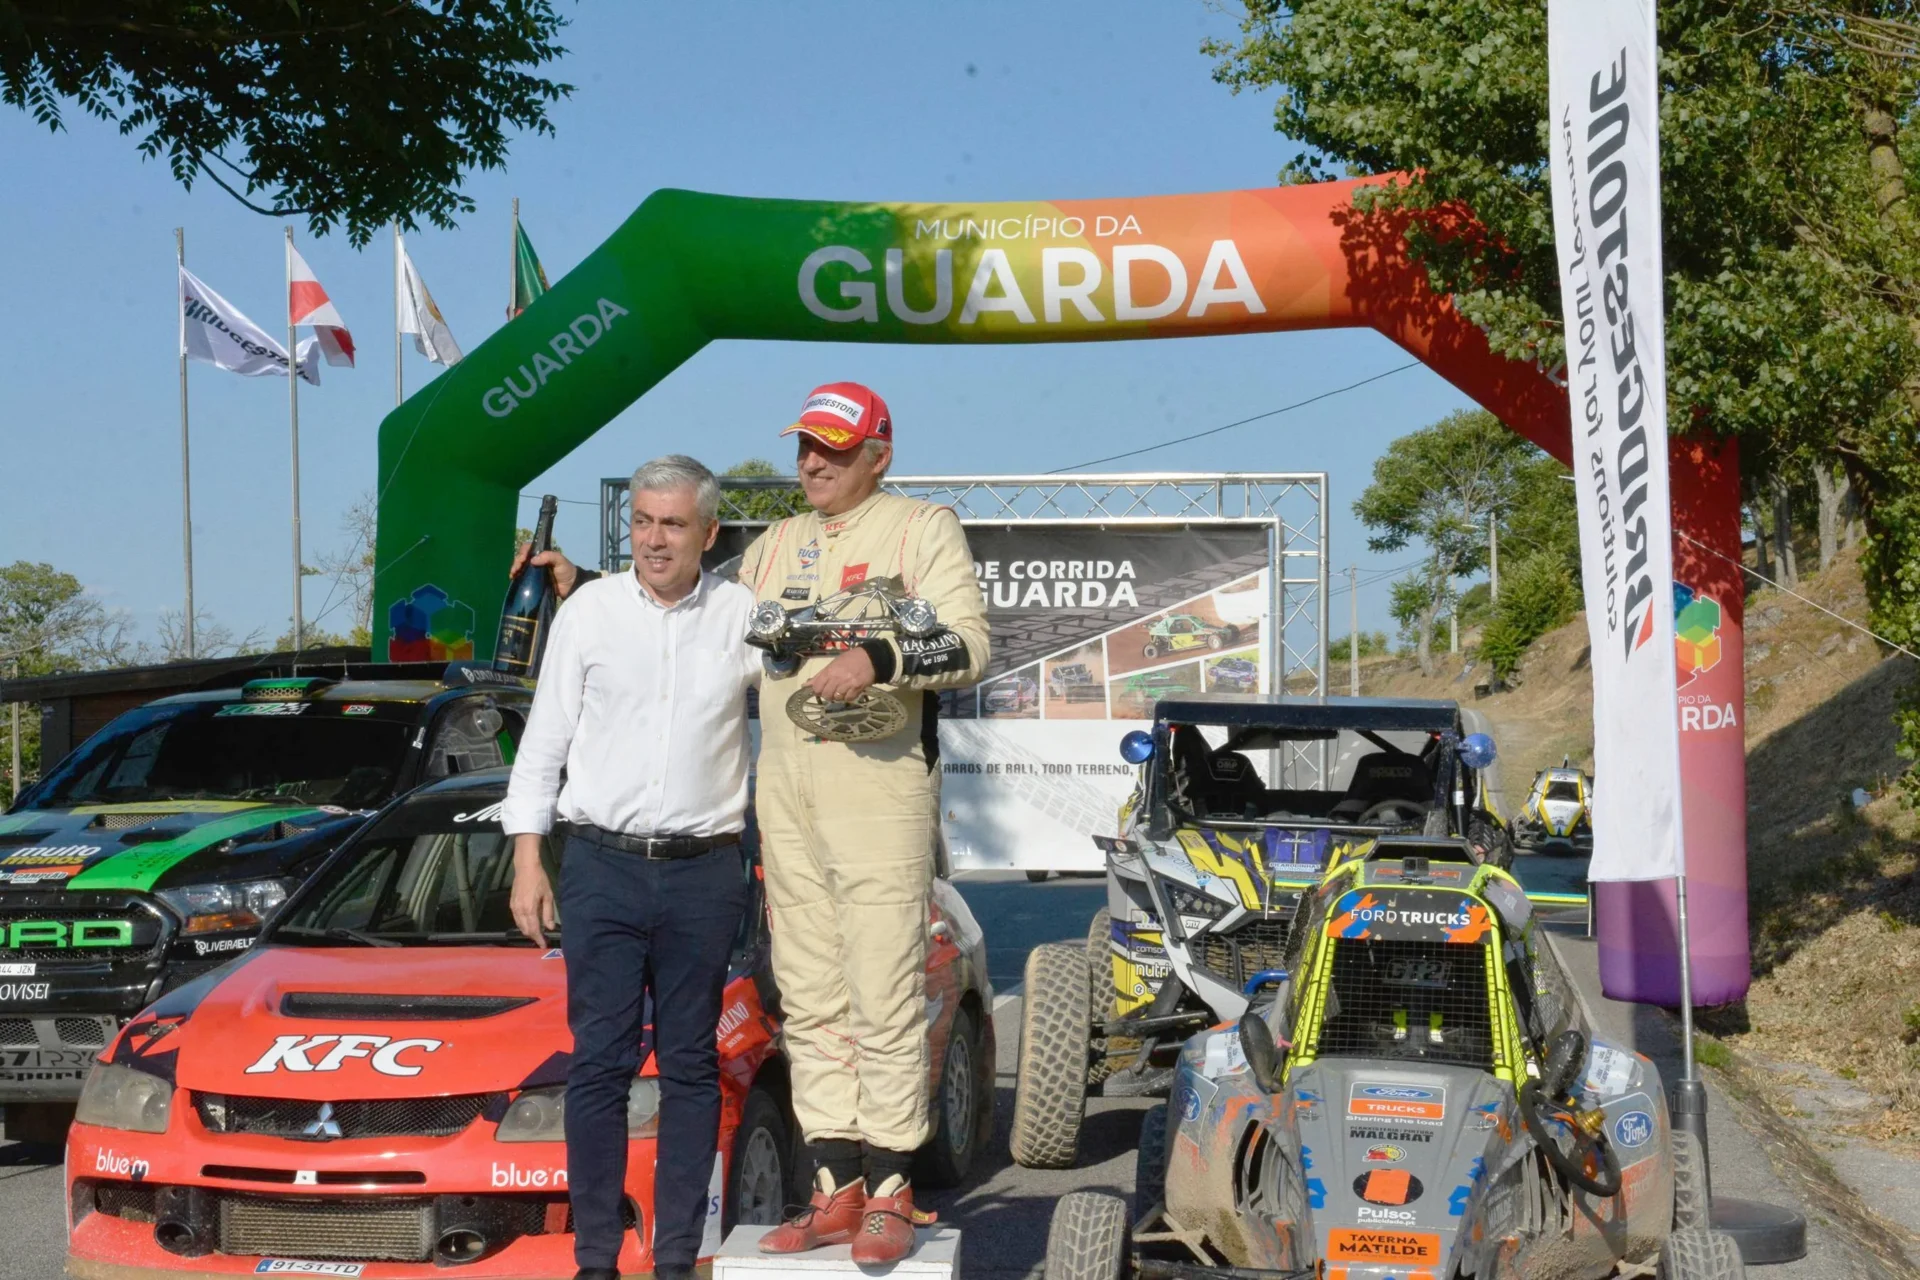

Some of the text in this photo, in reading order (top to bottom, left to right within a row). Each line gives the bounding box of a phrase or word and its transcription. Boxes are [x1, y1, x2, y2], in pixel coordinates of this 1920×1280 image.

[915, 213, 1142, 240] MUNICÍPIO DA
[798, 239, 1267, 325] GUARDA
[184, 295, 309, 380] BRIDGESTO
[481, 297, 629, 418] GUARDA
[825, 521, 846, 531] KFC
[1009, 560, 1136, 579] CORRIDA
[1698, 694, 1711, 704] DA
[1677, 702, 1737, 731] RDA
[942, 763, 1134, 778] ARROS DE RALI, TODO TERRENO,
[11, 845, 101, 857] muito
[0, 856, 89, 865] menos
[1350, 908, 1471, 926] FORD TRUCKS
[0, 921, 133, 948] RD
[1135, 961, 1172, 978] nutri
[716, 1001, 750, 1043] COLINO
[245, 1034, 443, 1077] KFC
[1367, 1103, 1426, 1114] TRUCKS
[1345, 1115, 1443, 1127] Sharing the load
[1350, 1130, 1434, 1143] MALGRAT
[1357, 1218, 1416, 1226] publicidade.pt
[1350, 1233, 1418, 1244] TAVERNA
[1340, 1243, 1428, 1256] MATILDE
[273, 1261, 359, 1274] 91-51-TD
